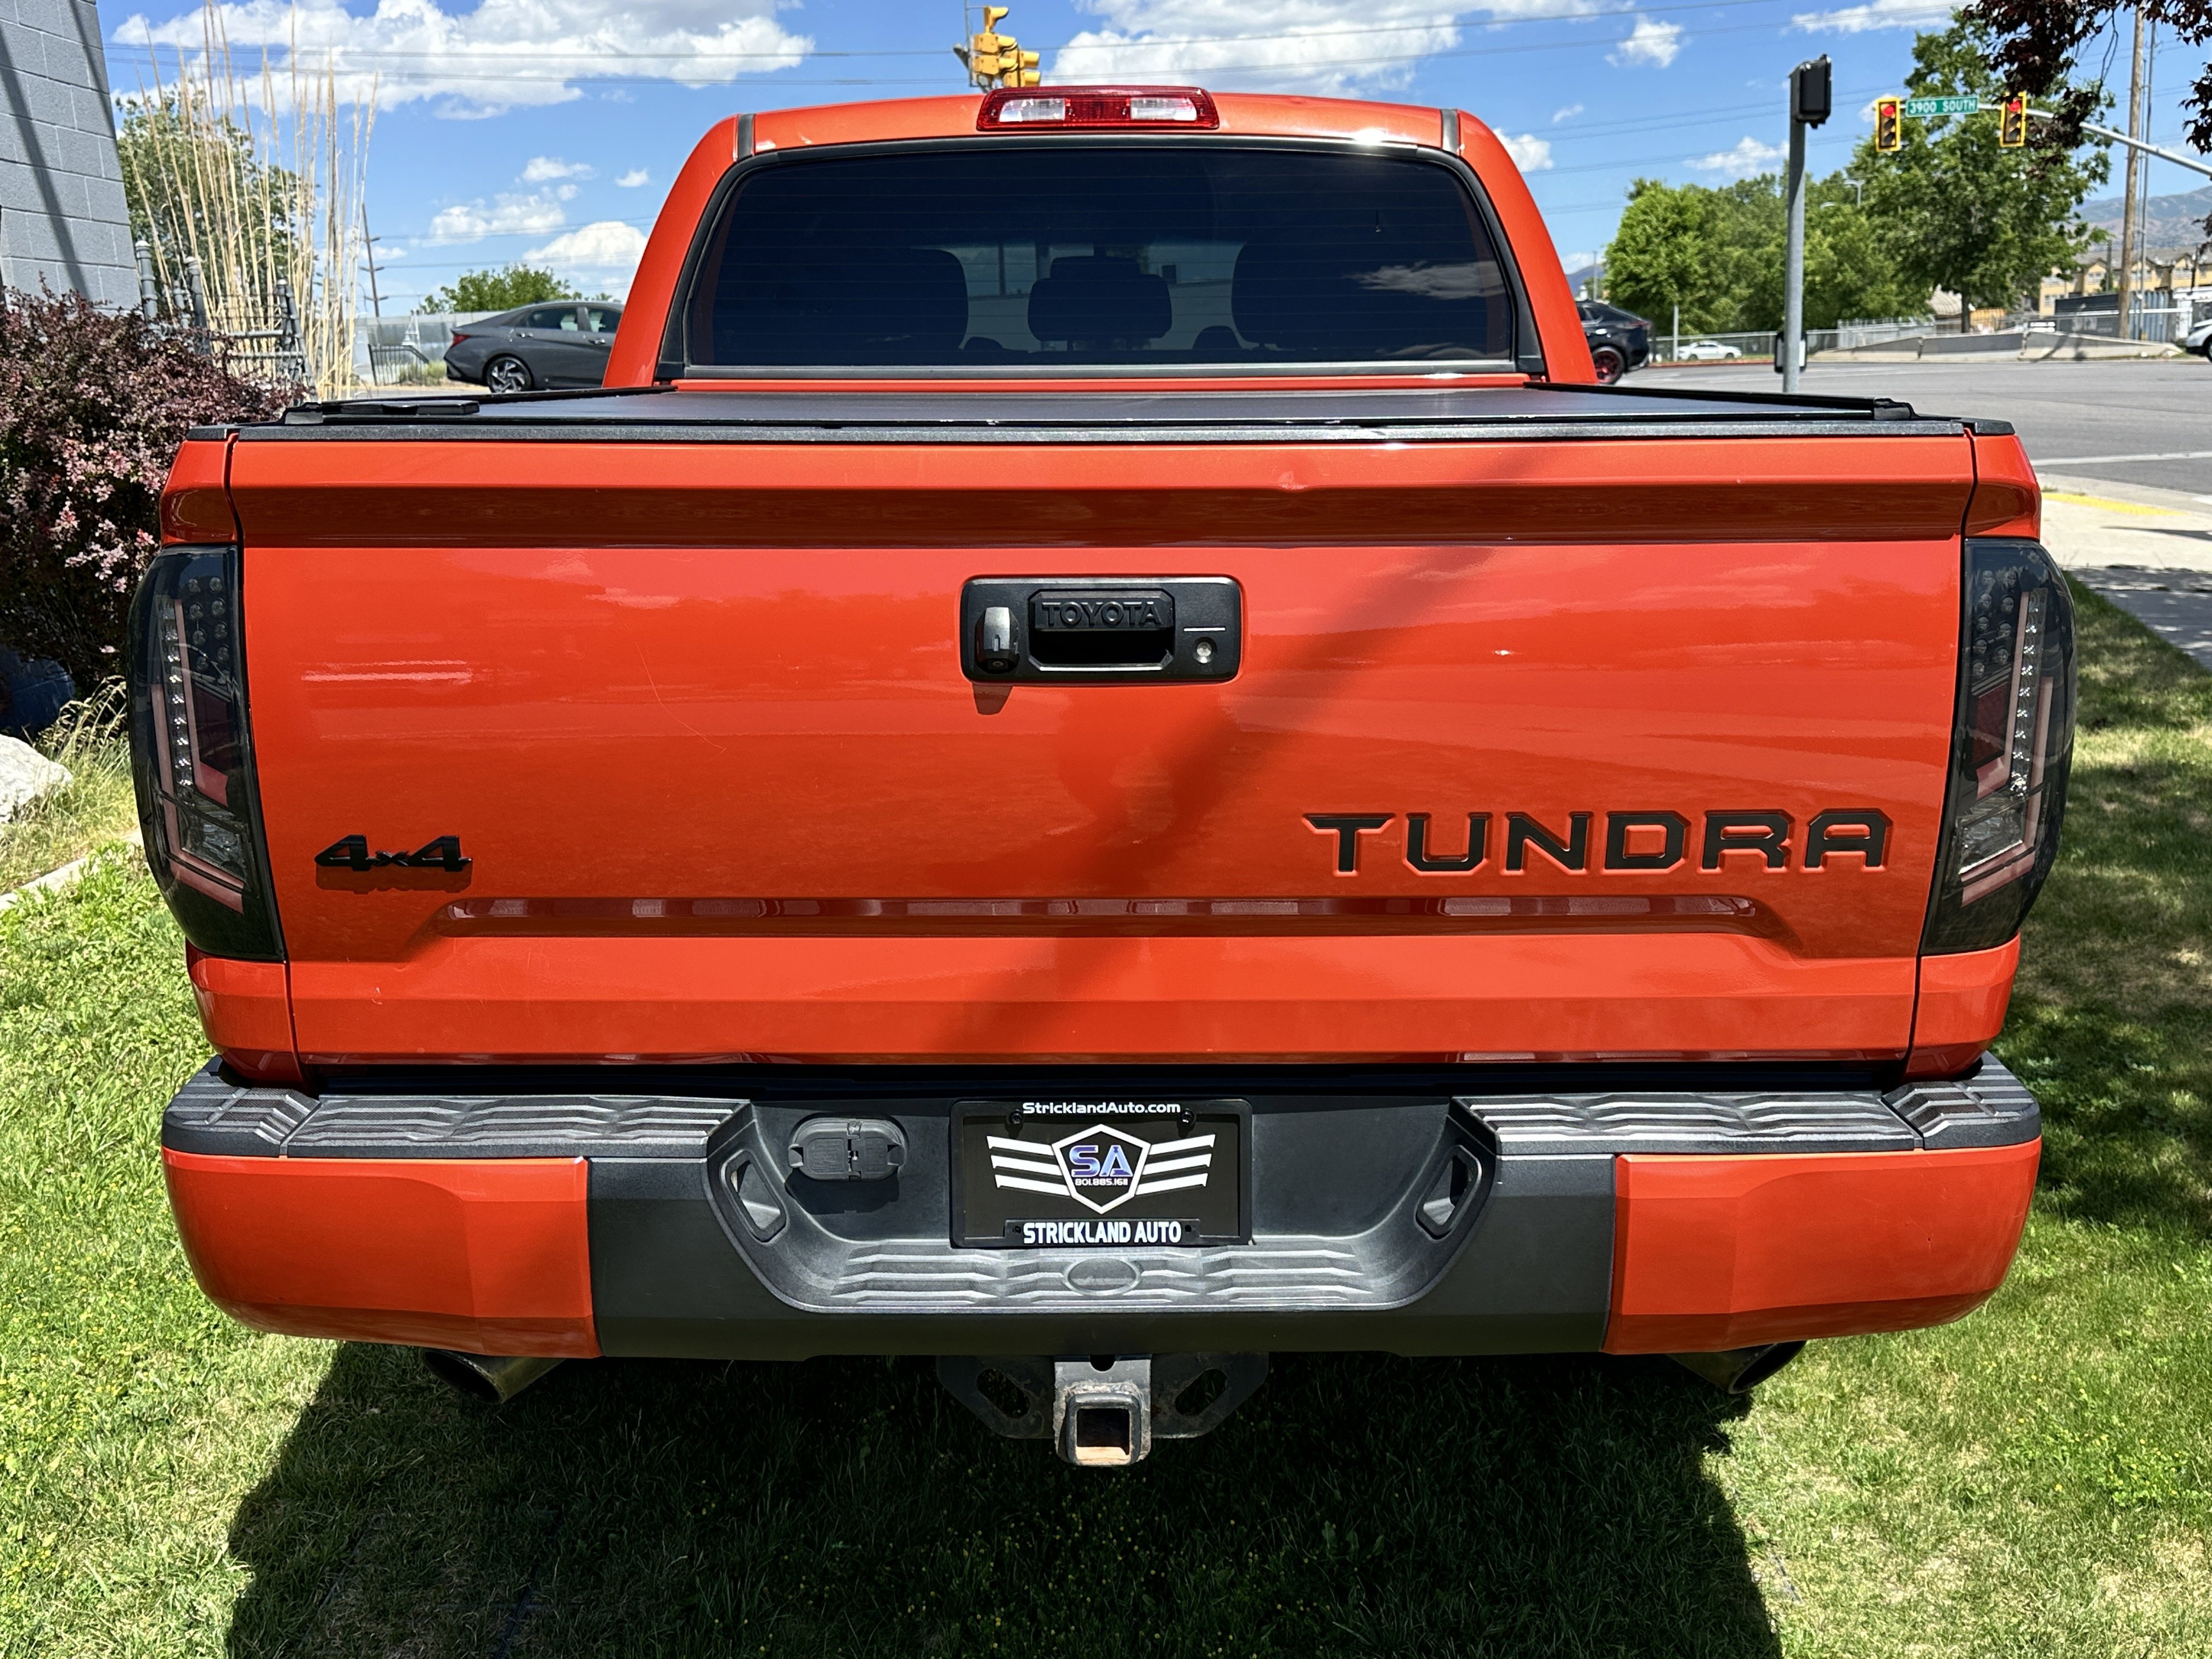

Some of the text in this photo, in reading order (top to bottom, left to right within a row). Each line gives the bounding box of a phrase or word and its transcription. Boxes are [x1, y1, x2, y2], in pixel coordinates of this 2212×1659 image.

[1909, 99, 1976, 114] 3900 SOUTH
[1041, 601, 1162, 628] TOYOTA
[314, 833, 473, 872] 4x4
[1304, 810, 1891, 875] TUNDRA
[1022, 1102, 1181, 1114] StricklandAuto.com
[1069, 1144, 1133, 1177] SA
[1074, 1178, 1128, 1186] 801.885.1611
[1023, 1221, 1182, 1244] STRICKLAND AUTO
